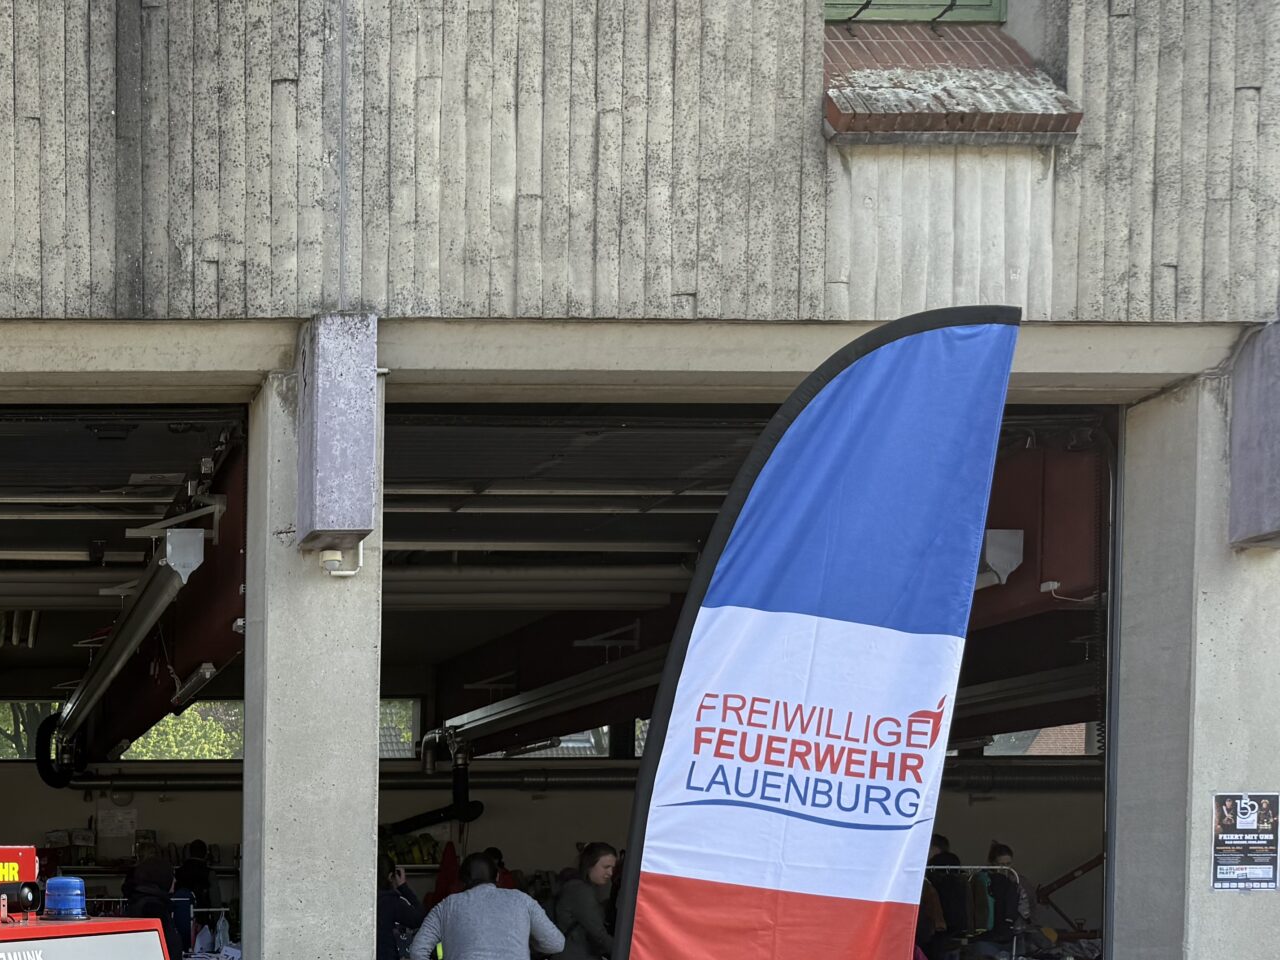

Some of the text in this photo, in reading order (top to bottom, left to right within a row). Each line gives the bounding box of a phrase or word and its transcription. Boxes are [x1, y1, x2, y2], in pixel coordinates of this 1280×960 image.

[695, 692, 932, 749] FREIWILLIGE
[693, 727, 924, 784] FEUERWEHR
[685, 760, 920, 819] LAUENBURG
